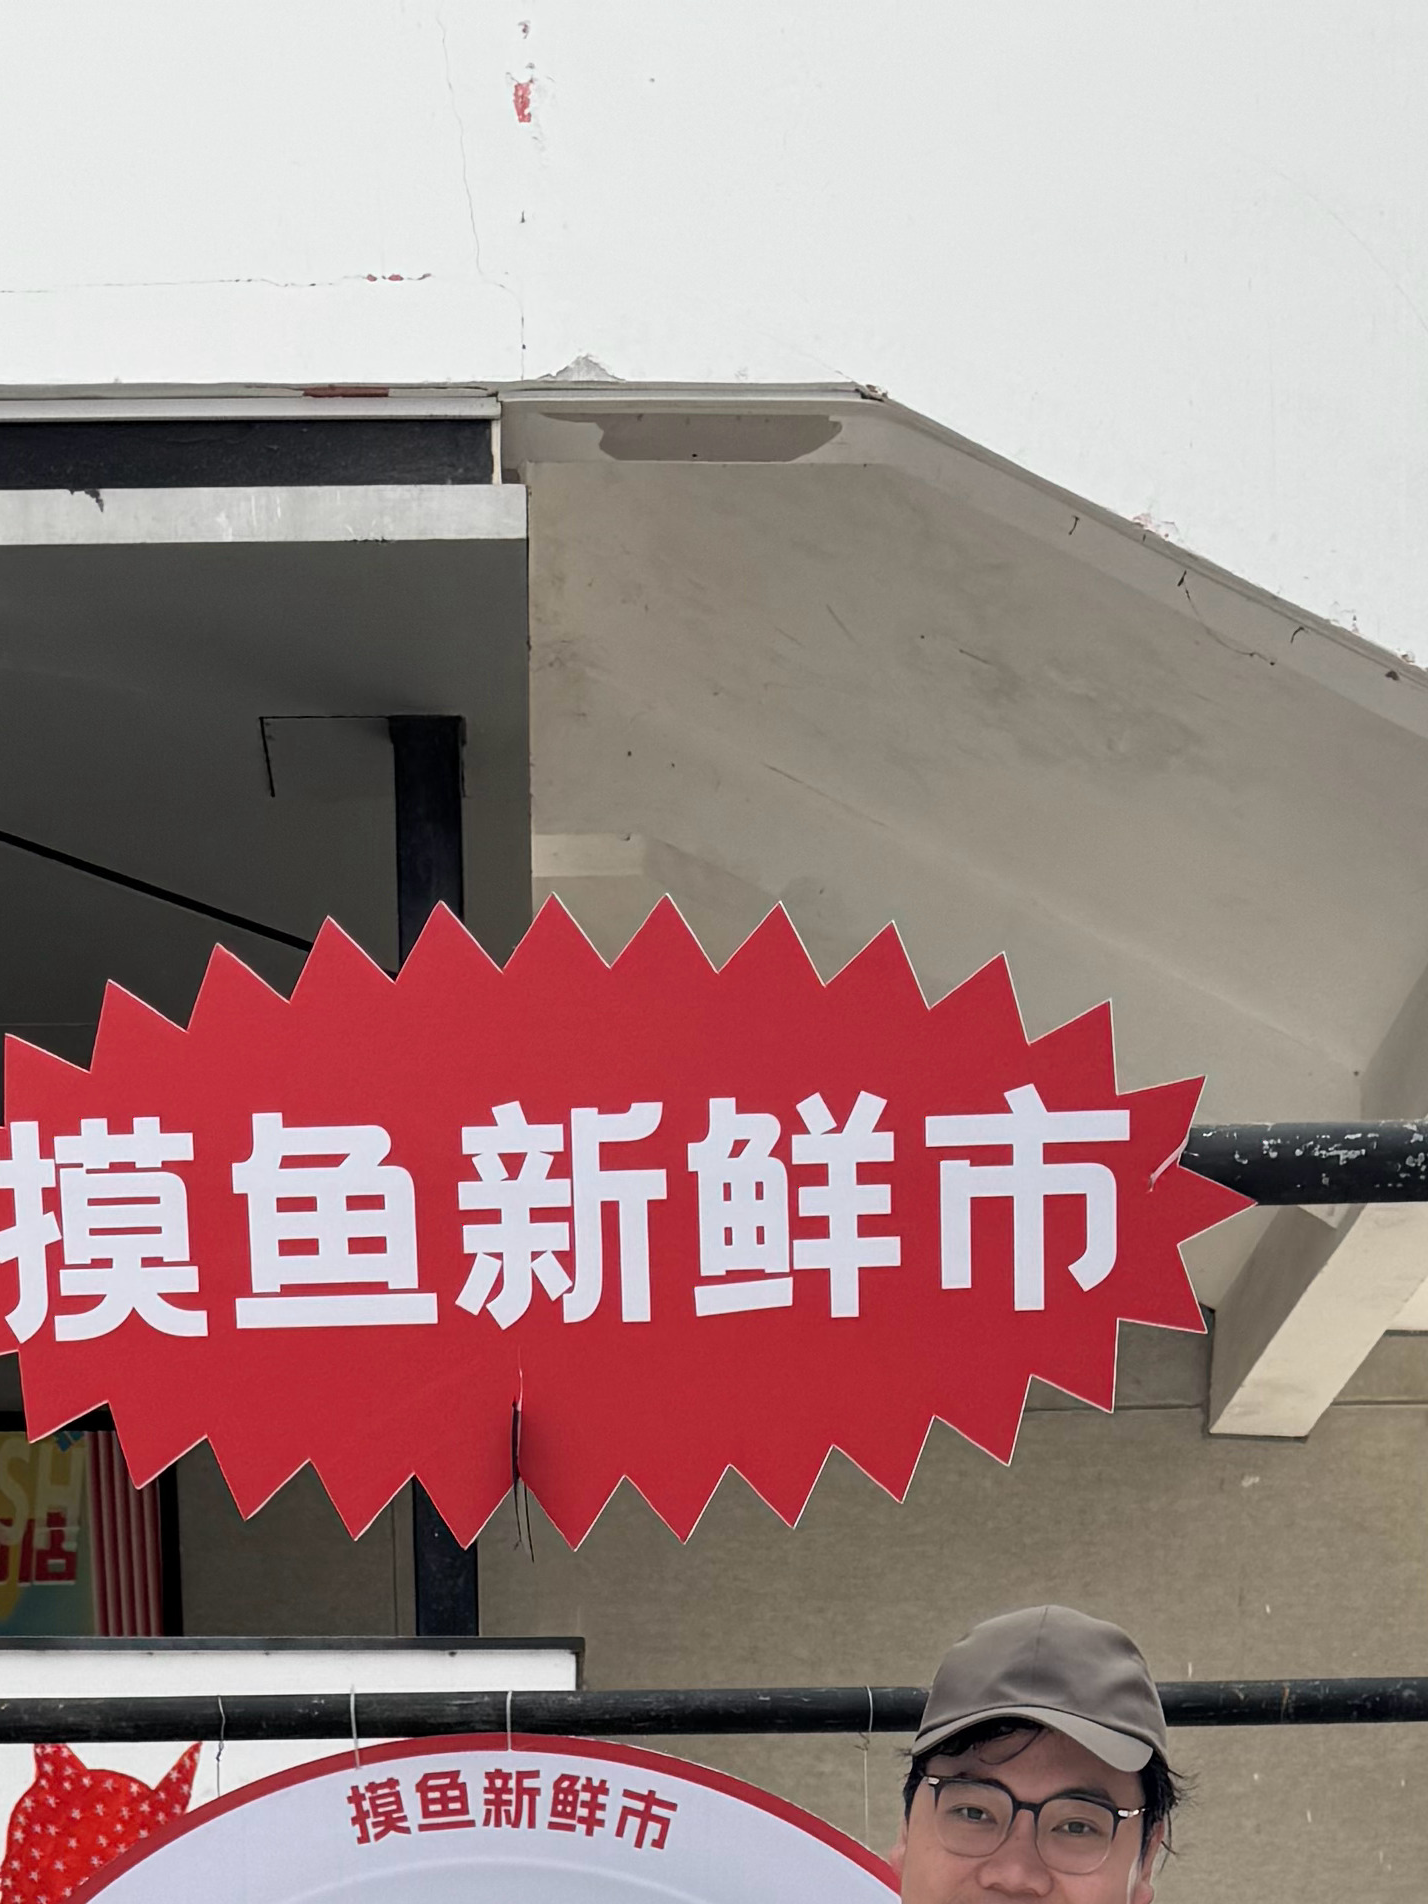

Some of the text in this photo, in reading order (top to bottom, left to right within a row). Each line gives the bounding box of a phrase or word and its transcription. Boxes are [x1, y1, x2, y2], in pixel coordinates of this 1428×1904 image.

[346, 1767, 678, 1851] 摸鱼新鲜市
